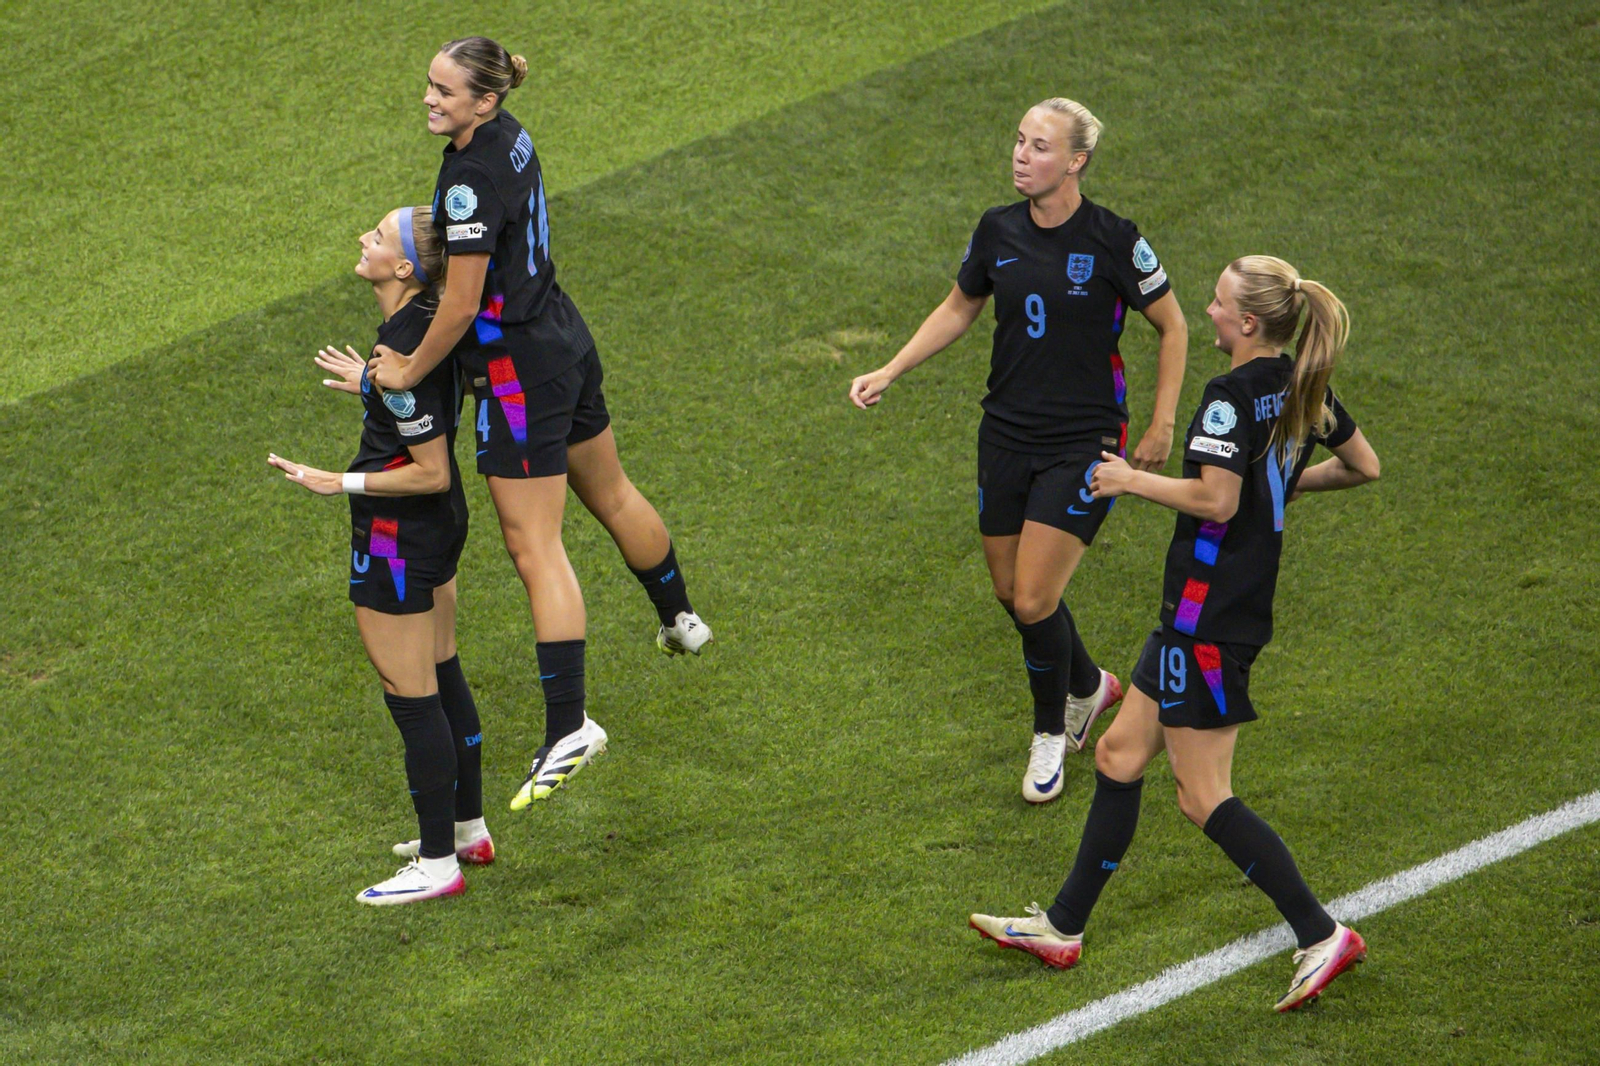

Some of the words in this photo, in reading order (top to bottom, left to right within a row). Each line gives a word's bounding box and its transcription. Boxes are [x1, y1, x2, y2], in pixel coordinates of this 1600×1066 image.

[1025, 293, 1047, 339] 9
[477, 398, 490, 442] 4
[1160, 645, 1187, 694] 19
